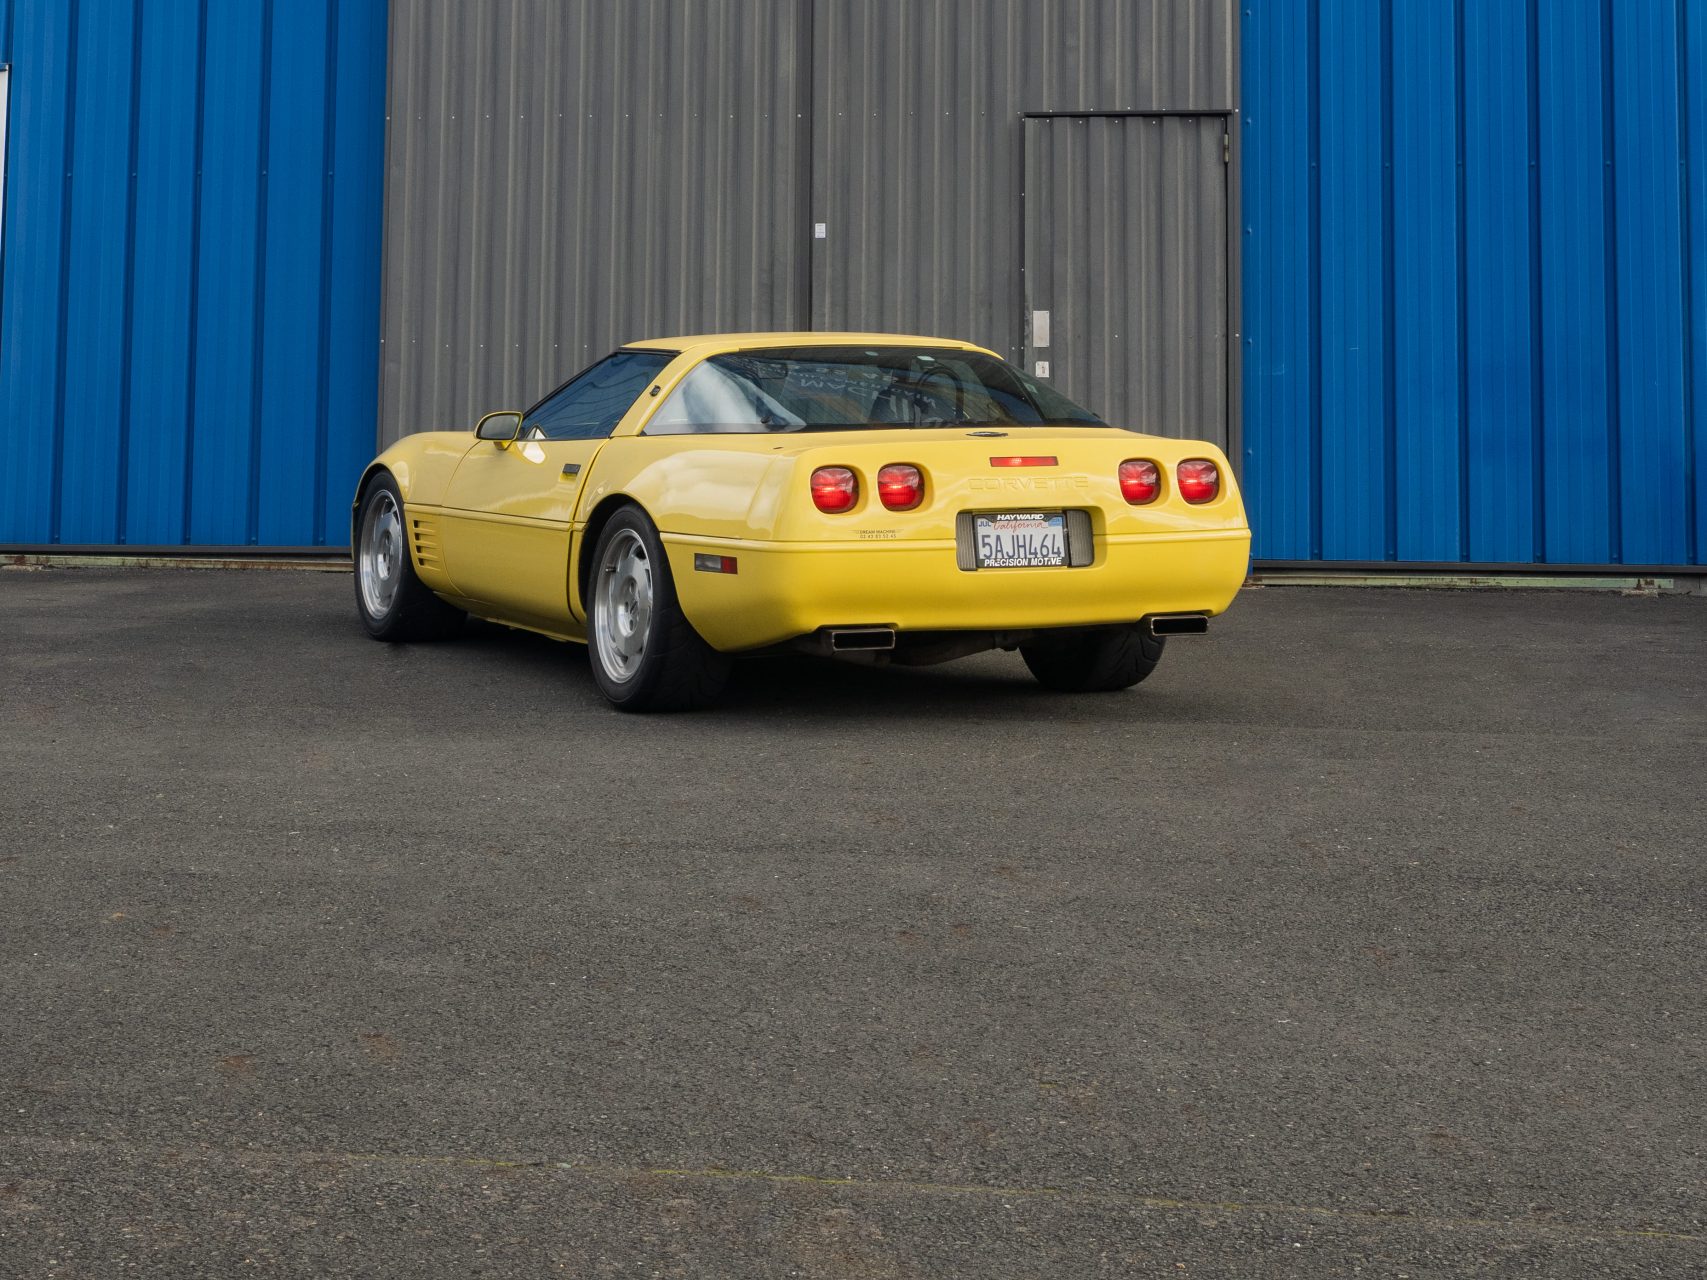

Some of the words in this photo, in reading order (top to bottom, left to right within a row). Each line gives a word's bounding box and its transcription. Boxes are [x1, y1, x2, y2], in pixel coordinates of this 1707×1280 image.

[968, 476, 1089, 490] CORVETTE
[993, 520, 1048, 533] California
[981, 534, 1062, 559] 5AJH464
[984, 559, 1029, 567] PRECISION
